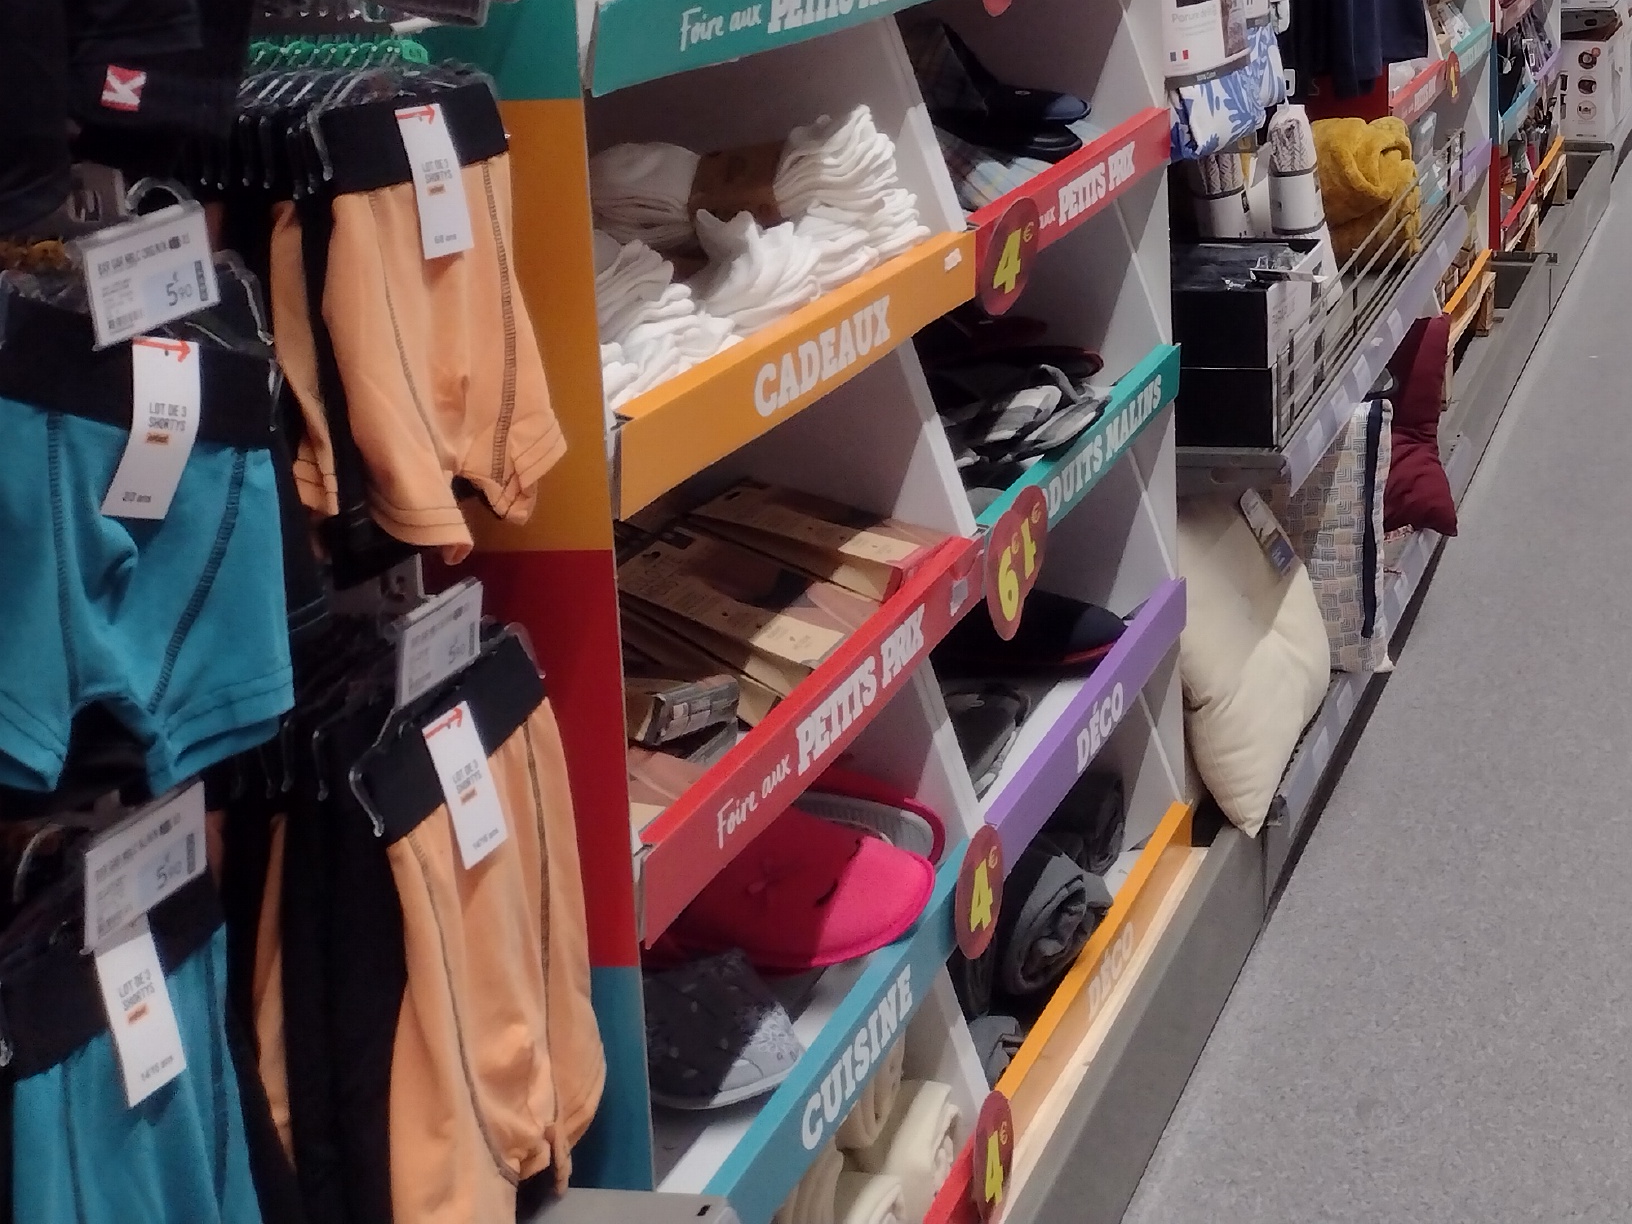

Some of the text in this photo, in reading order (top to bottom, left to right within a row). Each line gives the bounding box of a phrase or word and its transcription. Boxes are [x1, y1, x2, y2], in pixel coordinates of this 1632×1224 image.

[679, 5, 725, 53] Foire
[728, 2, 762, 33] aux
[1057, 141, 1136, 228] PETITS PRIX
[753, 295, 893, 419] CADEAUX
[1105, 373, 1163, 463] MALINS
[717, 603, 925, 850] Foire aux PETITS PRIX
[1075, 682, 1126, 774] DÉCO
[1086, 920, 1135, 1021] DÉCO
[799, 964, 914, 1151] CUISINE
